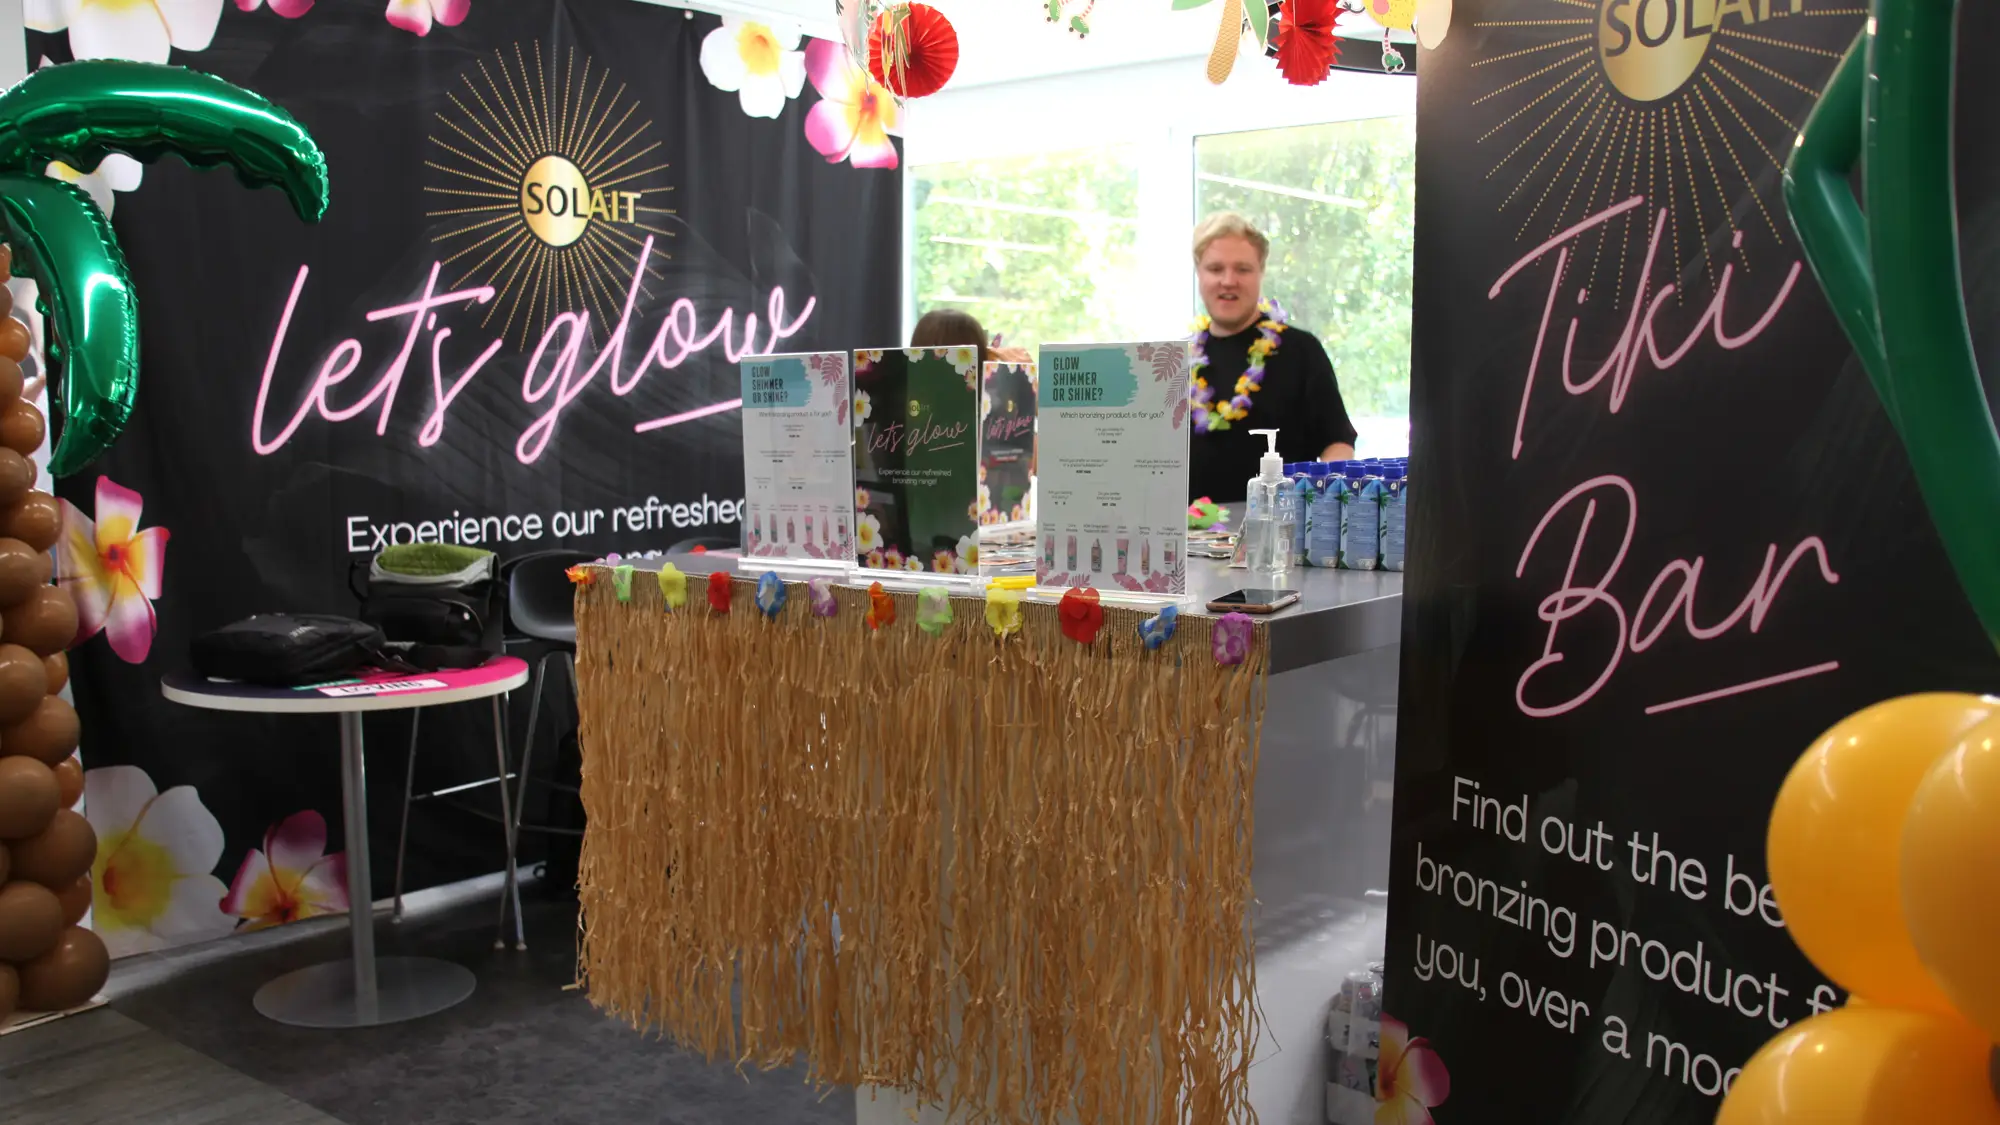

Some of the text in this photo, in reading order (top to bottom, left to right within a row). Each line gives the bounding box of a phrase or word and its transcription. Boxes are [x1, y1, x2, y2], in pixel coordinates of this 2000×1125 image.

[527, 182, 642, 224] SOLAIT
[1488, 195, 1801, 459] Tiki
[516, 235, 817, 464] glow
[1053, 357, 1080, 370] GLOW
[752, 366, 771, 378] GLOW
[752, 379, 784, 391] SHIMMER
[1053, 373, 1097, 386] SHIMMER
[752, 392, 762, 404] OR
[1053, 387, 1104, 401] OR SHINE?
[1079, 411, 1106, 420] bronzing
[1106, 411, 1131, 420] product
[1149, 411, 1165, 420] you?
[906, 412, 968, 456] glow
[347, 510, 543, 552] Experience
[553, 508, 604, 537] our
[1516, 475, 1839, 717] Bar
[1453, 776, 1787, 928] Find out the be
[1415, 842, 1577, 958] bronzing
[1590, 921, 1790, 1029] product
[1413, 933, 1487, 1001] you,
[1500, 971, 1590, 1034] over
[1602, 1015, 1631, 1059] a
